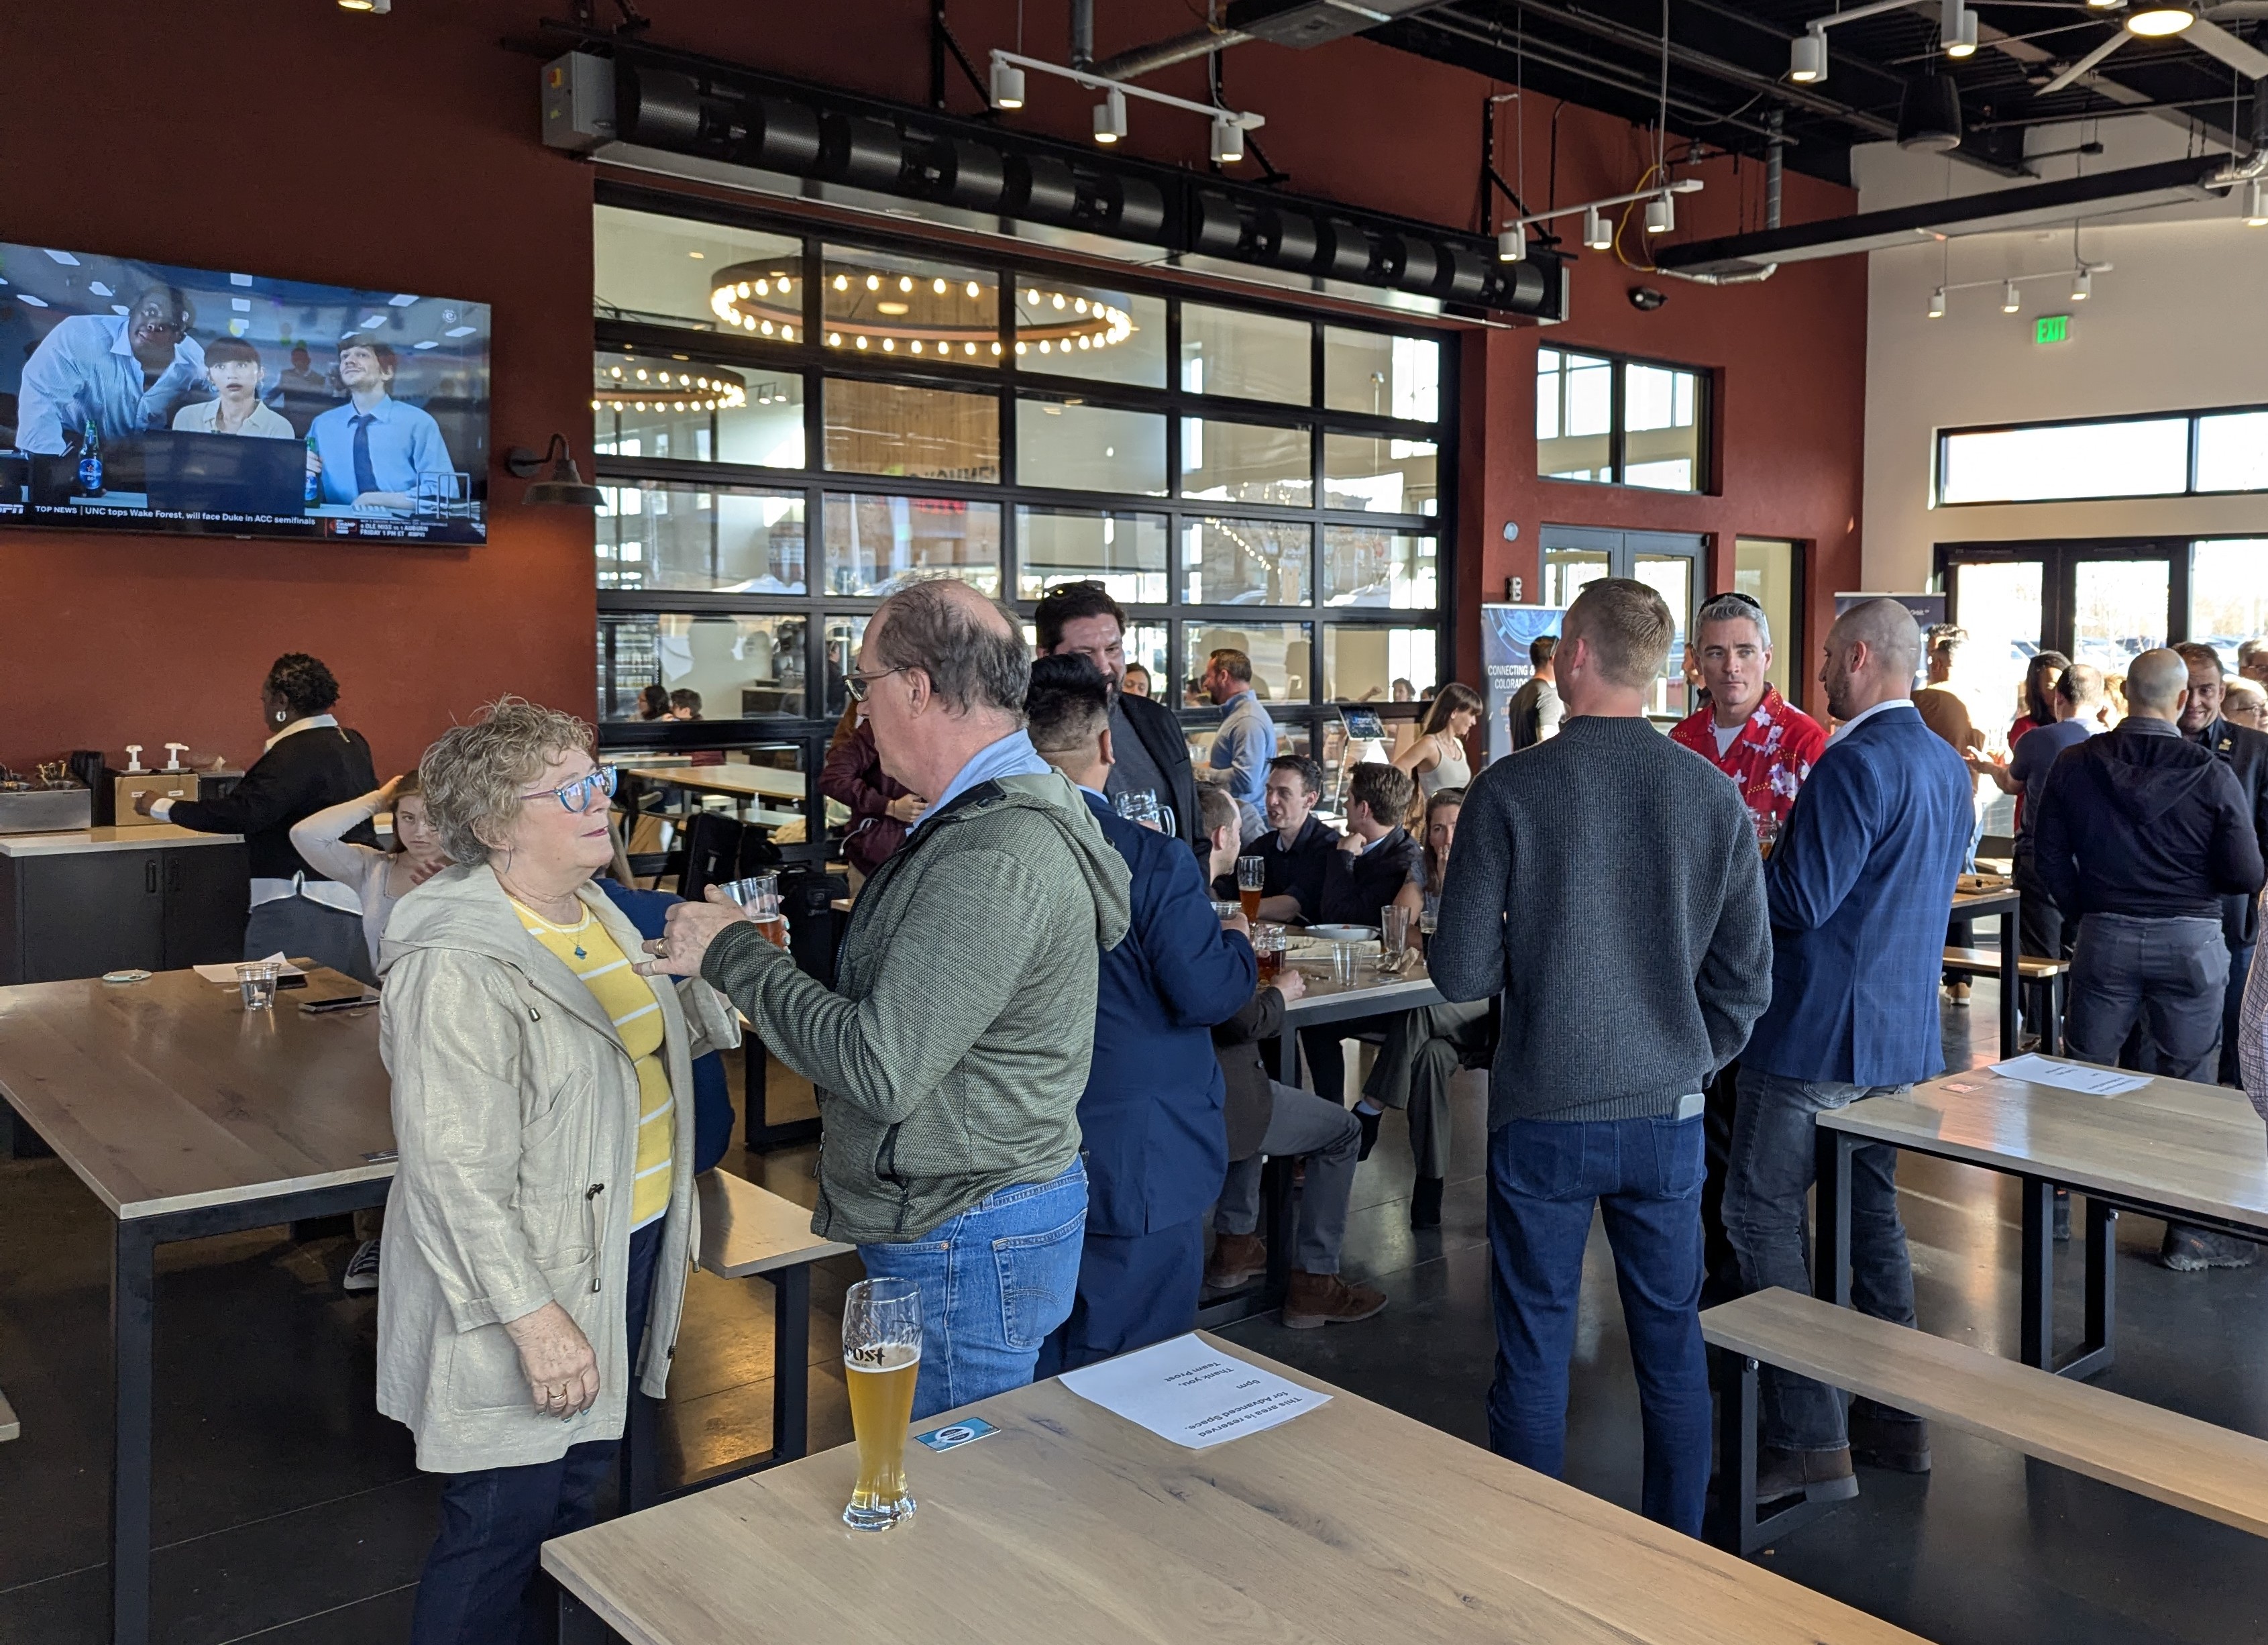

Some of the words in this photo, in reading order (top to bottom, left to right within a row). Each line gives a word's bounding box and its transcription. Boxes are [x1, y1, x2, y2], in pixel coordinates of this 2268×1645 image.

[2037, 315, 2069, 343] EXIT
[85, 507, 106, 515] UNC
[108, 509, 128, 518] tops
[129, 509, 153, 517] Wake
[202, 513, 221, 521] face
[222, 513, 244, 522] Duke
[246, 515, 254, 523] in
[254, 515, 273, 523] ACC
[274, 517, 316, 525] semifinals
[1488, 665, 1528, 676] CONNECTING
[1529, 665, 1535, 676] &
[844, 1344, 885, 1366] rost
[1192, 1362, 1221, 1372] Team
[1201, 1367, 1234, 1379] Thank
[1164, 1371, 1193, 1382] Prost
[1236, 1379, 1260, 1389] 5pm
[1222, 1397, 1273, 1418] Advanced
[1279, 1397, 1303, 1407] This
[1255, 1405, 1279, 1416] area
[1185, 1415, 1223, 1430] Space.
[1198, 1418, 1244, 1437] reserved
